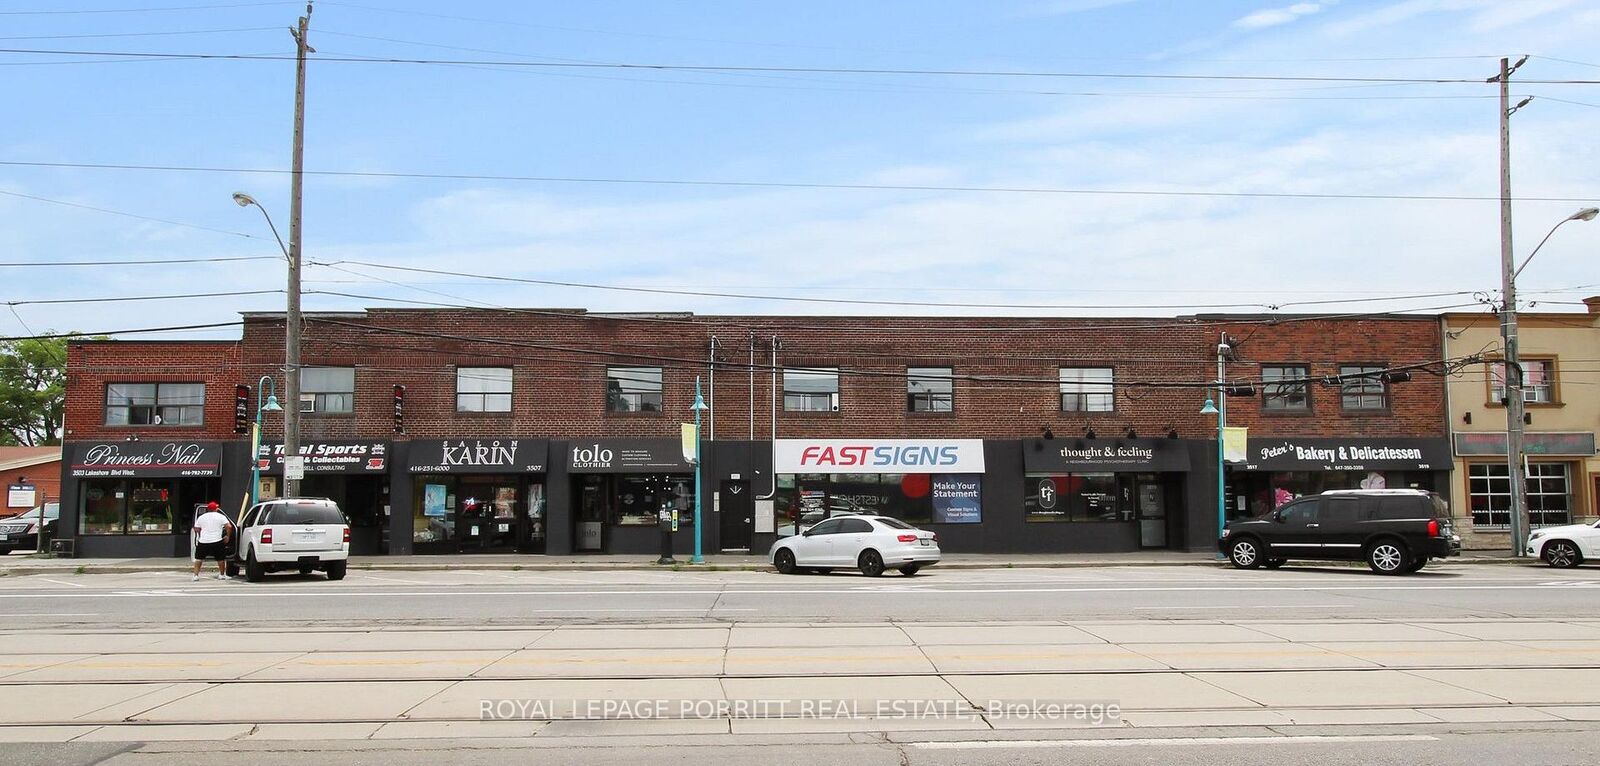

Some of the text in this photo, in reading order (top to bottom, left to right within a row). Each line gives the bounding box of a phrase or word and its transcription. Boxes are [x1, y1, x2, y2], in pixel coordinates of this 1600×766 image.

[84, 443, 205, 466] Princess Nail
[274, 444, 367, 455] Tal Sports
[441, 447, 518, 465] KARIN
[573, 444, 613, 462] tolo
[801, 446, 958, 465] FASTSIGNS
[1061, 447, 1152, 459] thought & feeling
[1261, 442, 1294, 460] Peter's
[1297, 446, 1421, 463] Bakery & Delicatessen
[933, 482, 976, 490] Make Your
[934, 490, 978, 498] Statement
